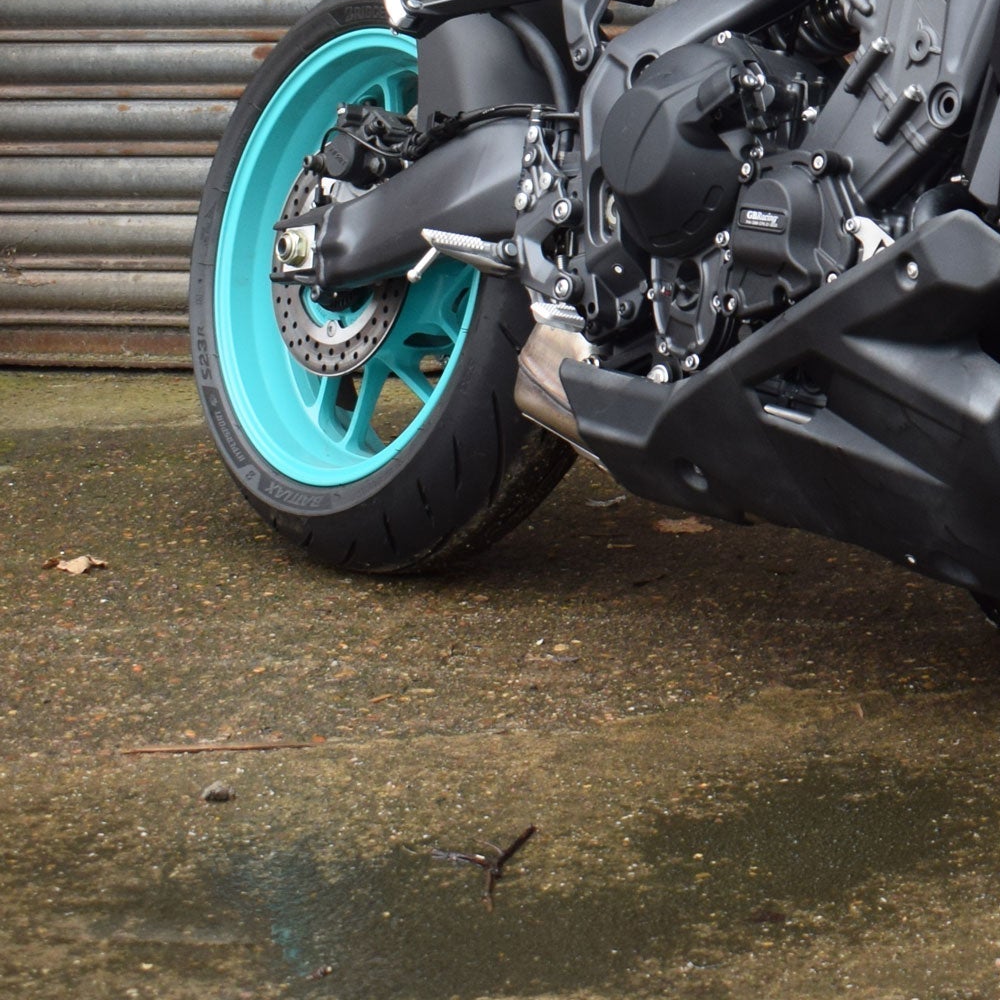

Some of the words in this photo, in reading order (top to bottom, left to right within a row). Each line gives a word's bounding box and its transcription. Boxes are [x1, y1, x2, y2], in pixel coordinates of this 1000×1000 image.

[344, 5, 386, 22] BRIDGE
[215, 411, 246, 464] HYPERSPORT
[266, 482, 322, 508] BATTLAX
